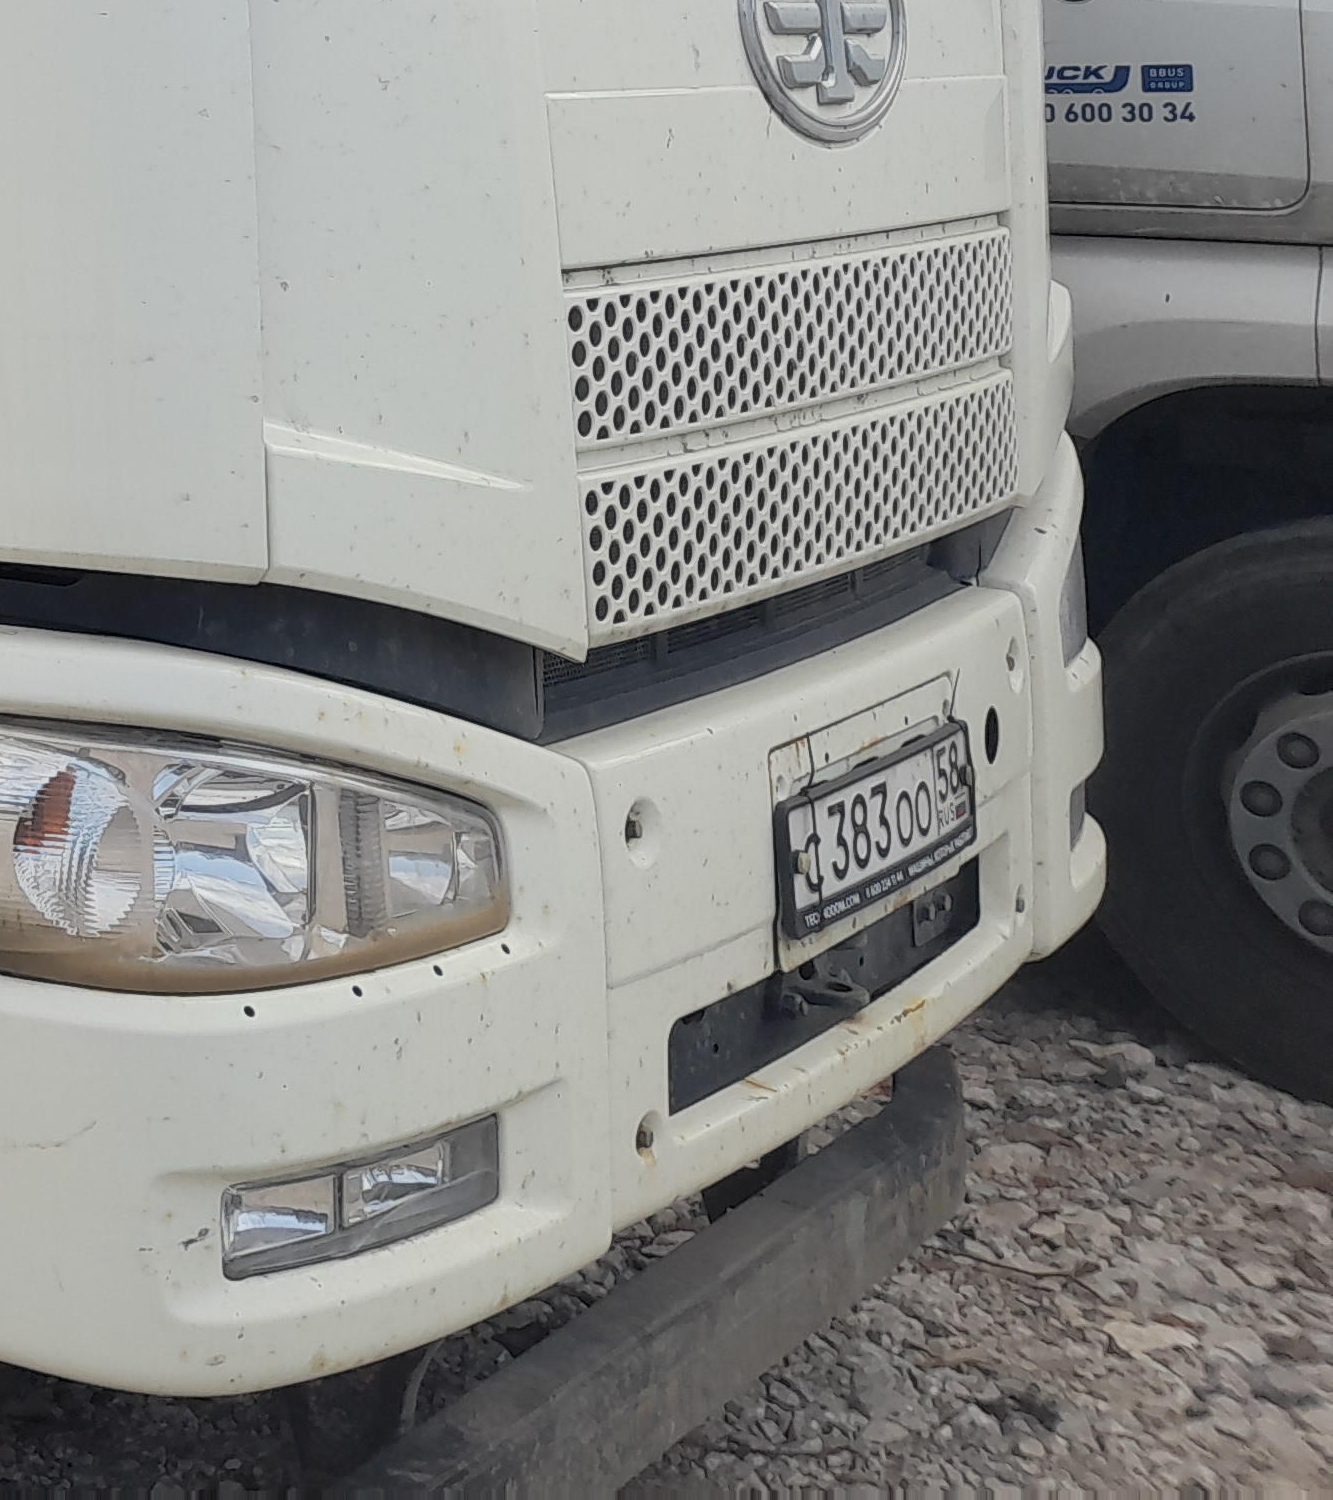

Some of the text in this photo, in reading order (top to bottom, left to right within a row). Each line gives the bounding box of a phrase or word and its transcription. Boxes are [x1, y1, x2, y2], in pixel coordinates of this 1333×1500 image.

[1149, 67, 1184, 78] BBUS
[1064, 102, 1112, 123] 600
[1121, 102, 1153, 123] 30
[1162, 101, 1196, 123] 34
[936, 739, 960, 805] 58
[938, 801, 955, 828] RUS
